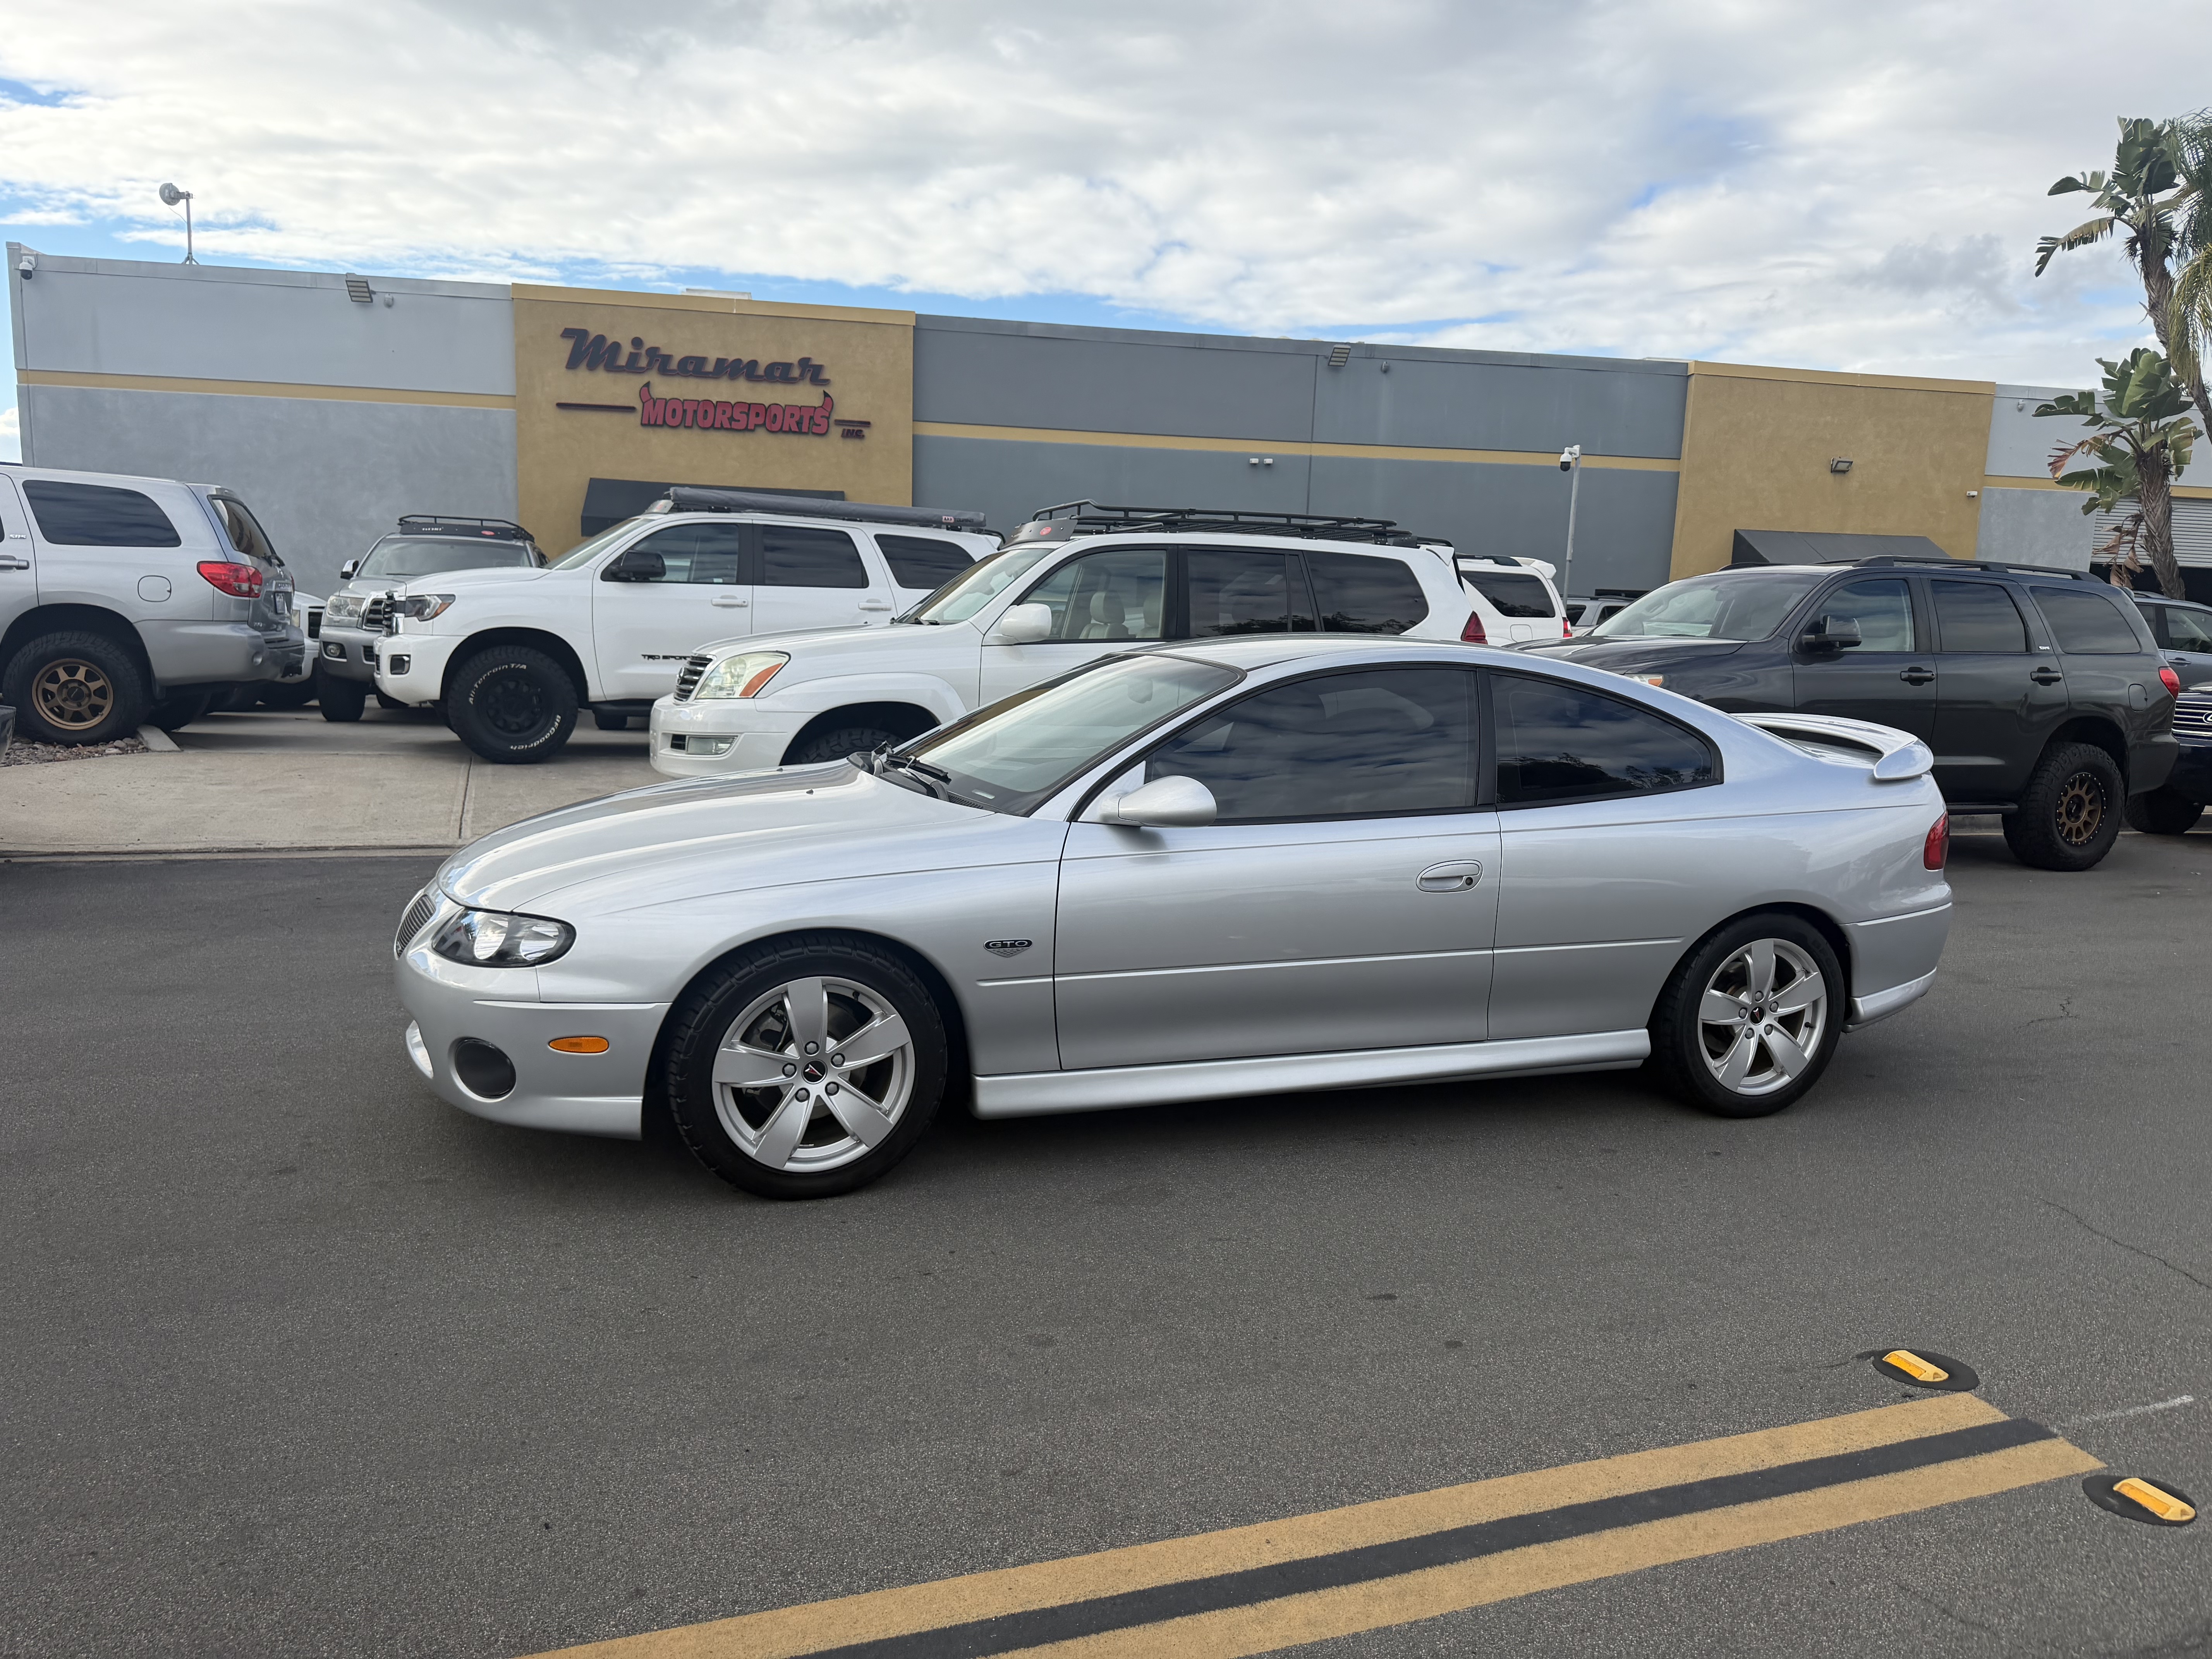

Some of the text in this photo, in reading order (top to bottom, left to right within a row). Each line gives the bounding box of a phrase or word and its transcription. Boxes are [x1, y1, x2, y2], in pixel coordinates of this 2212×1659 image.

[560, 328, 830, 385] Miramar
[641, 397, 866, 438] MOTORSPORTS INC.
[510, 714, 562, 750] BFGoodrich
